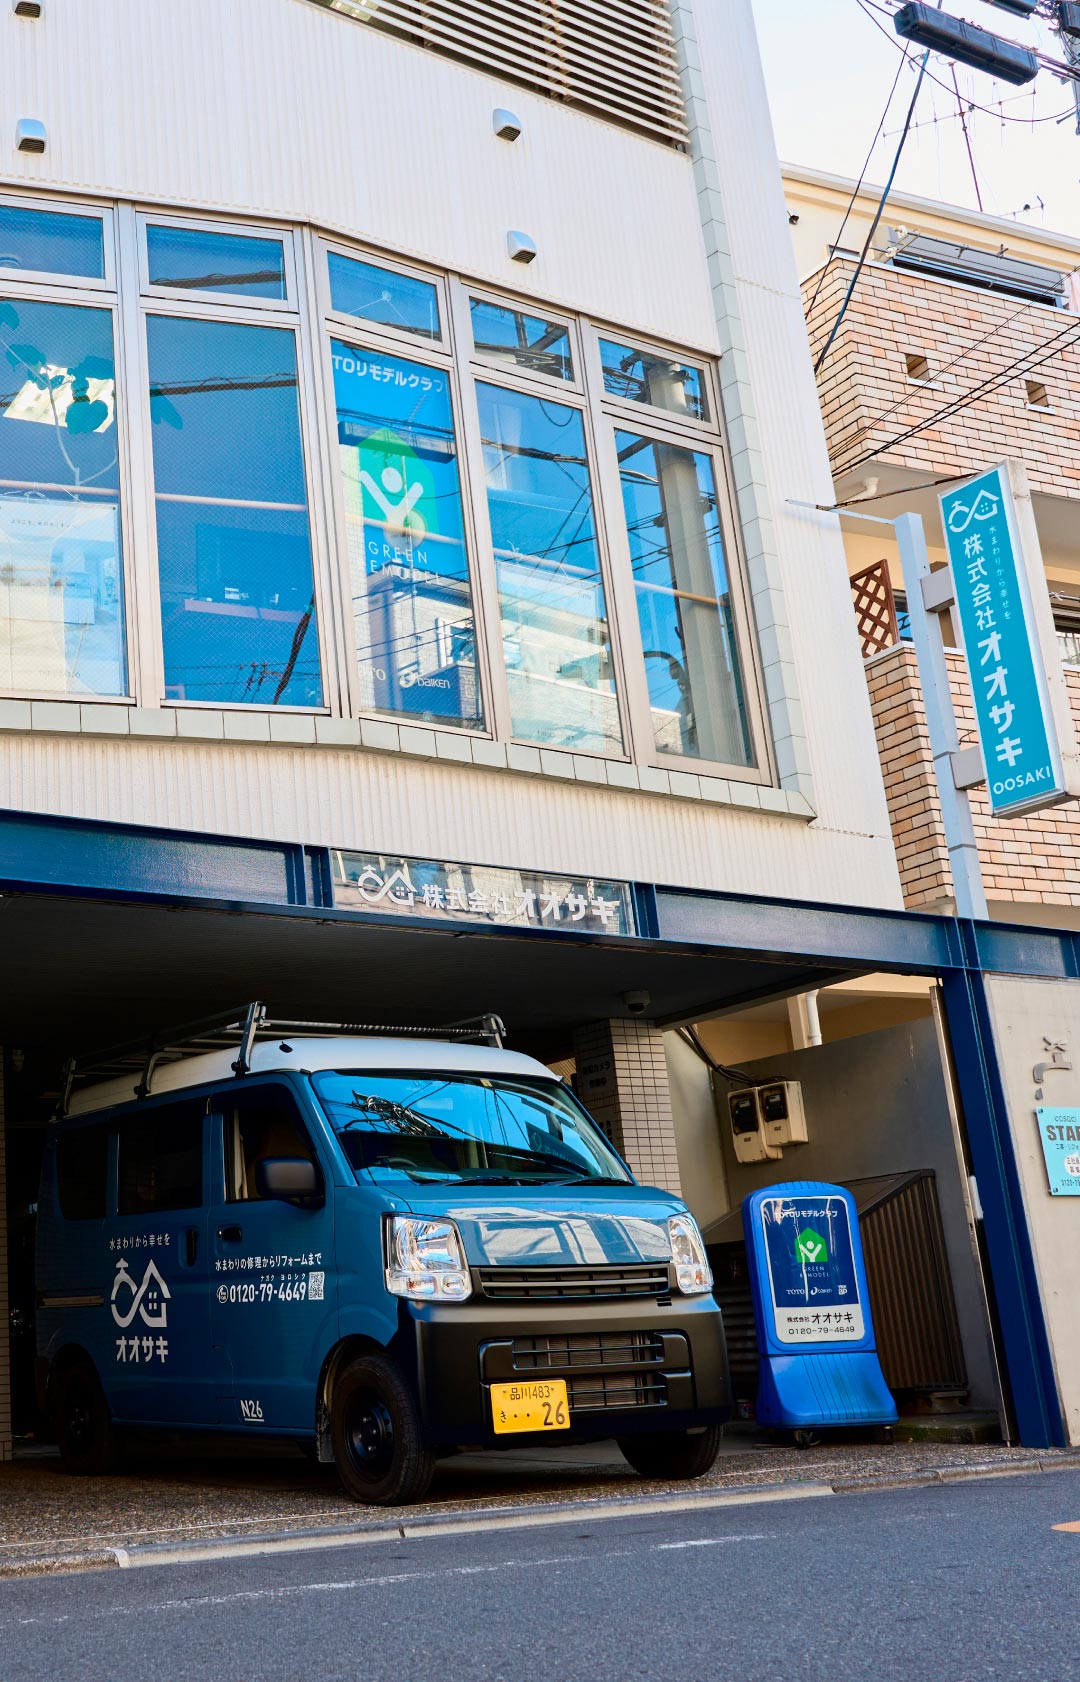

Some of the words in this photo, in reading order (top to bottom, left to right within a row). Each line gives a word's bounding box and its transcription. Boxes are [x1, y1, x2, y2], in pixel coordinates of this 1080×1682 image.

[368, 541, 428, 564] GREEN
[962, 532, 1023, 768] 株式会社オオサキ
[992, 764, 1052, 796] OOSAKI
[421, 883, 615, 925] 株式会社オオサキ
[109, 1232, 171, 1251] 水まわりから幸せを
[215, 1252, 322, 1271] 水まわりの修理からリフォームまで
[229, 1281, 307, 1303] 0120-79-4649
[115, 1335, 169, 1364] オオサキ
[240, 1399, 263, 1418] N26
